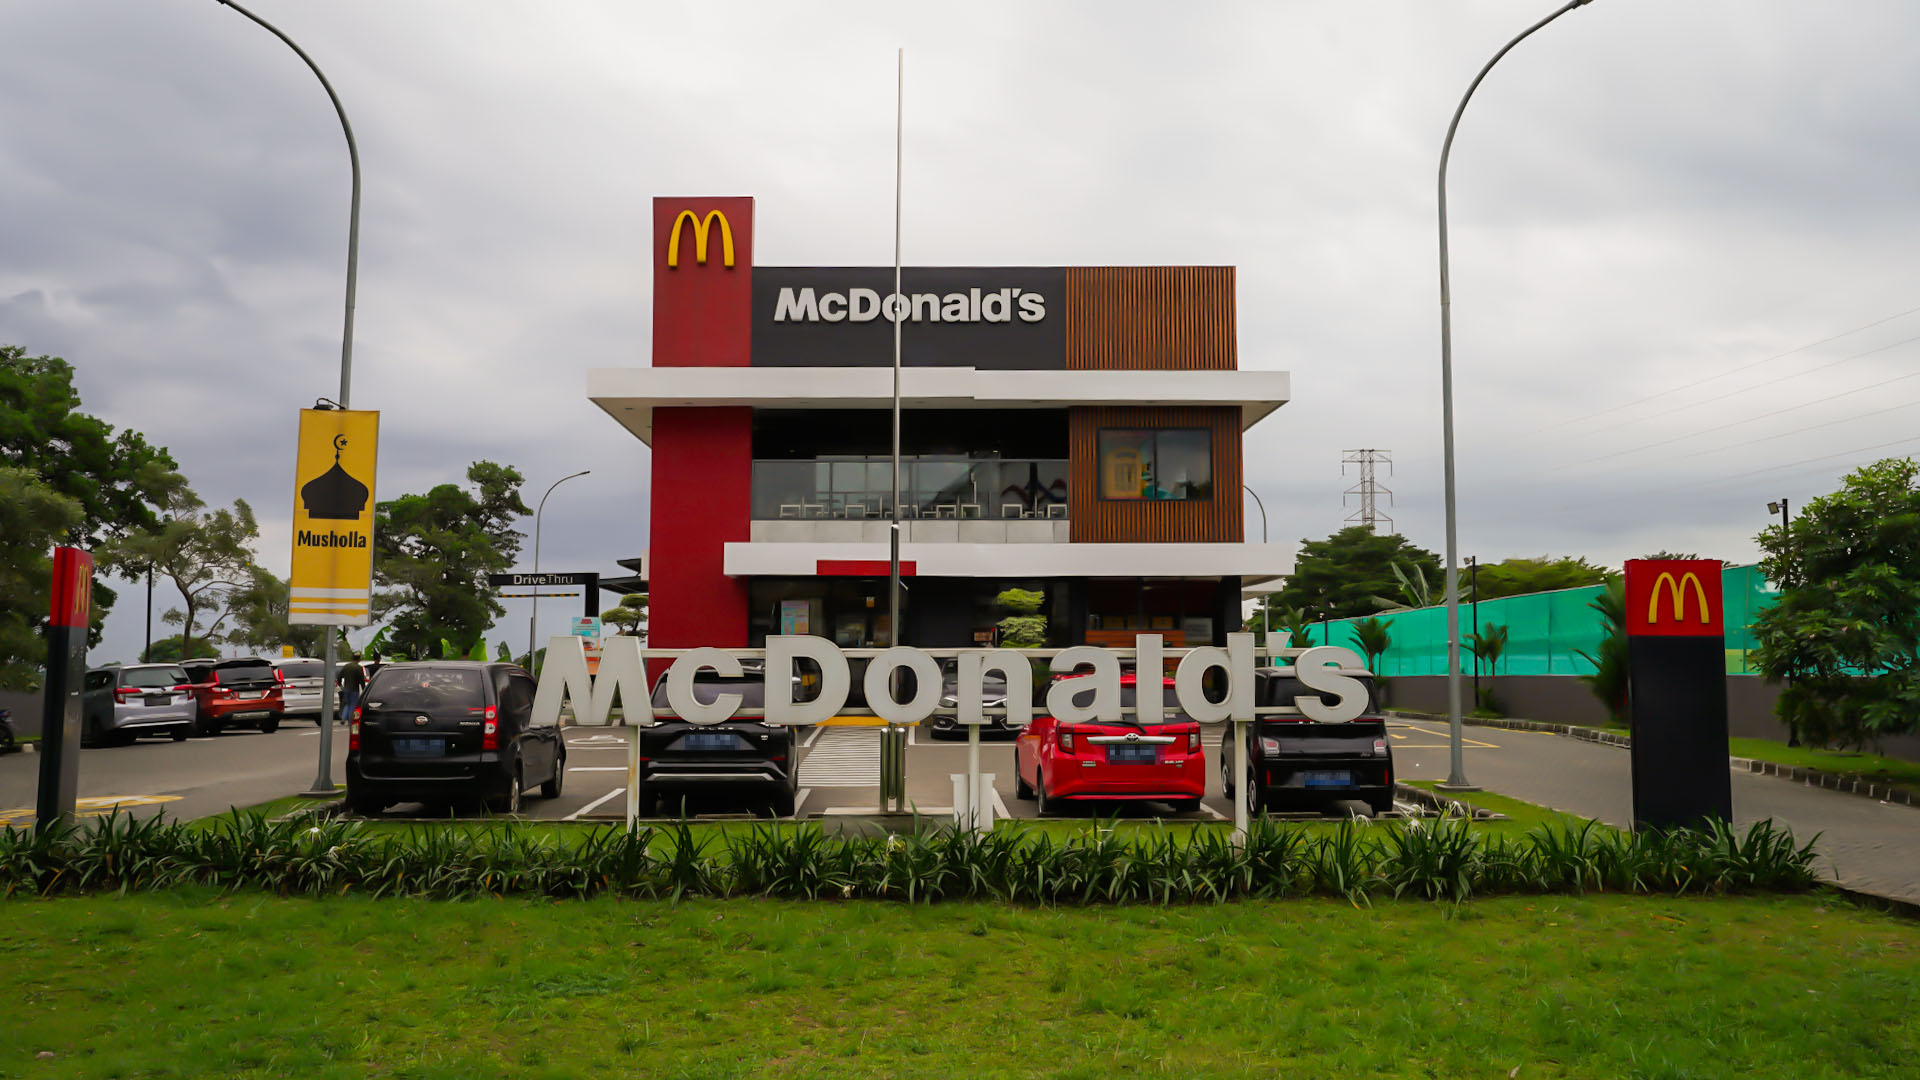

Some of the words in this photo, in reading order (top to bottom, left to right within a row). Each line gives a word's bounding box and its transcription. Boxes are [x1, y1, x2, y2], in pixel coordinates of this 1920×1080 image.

[774, 287, 1046, 323] McDonald's
[297, 529, 367, 549] Musholla
[529, 632, 1369, 726] McDonald's
